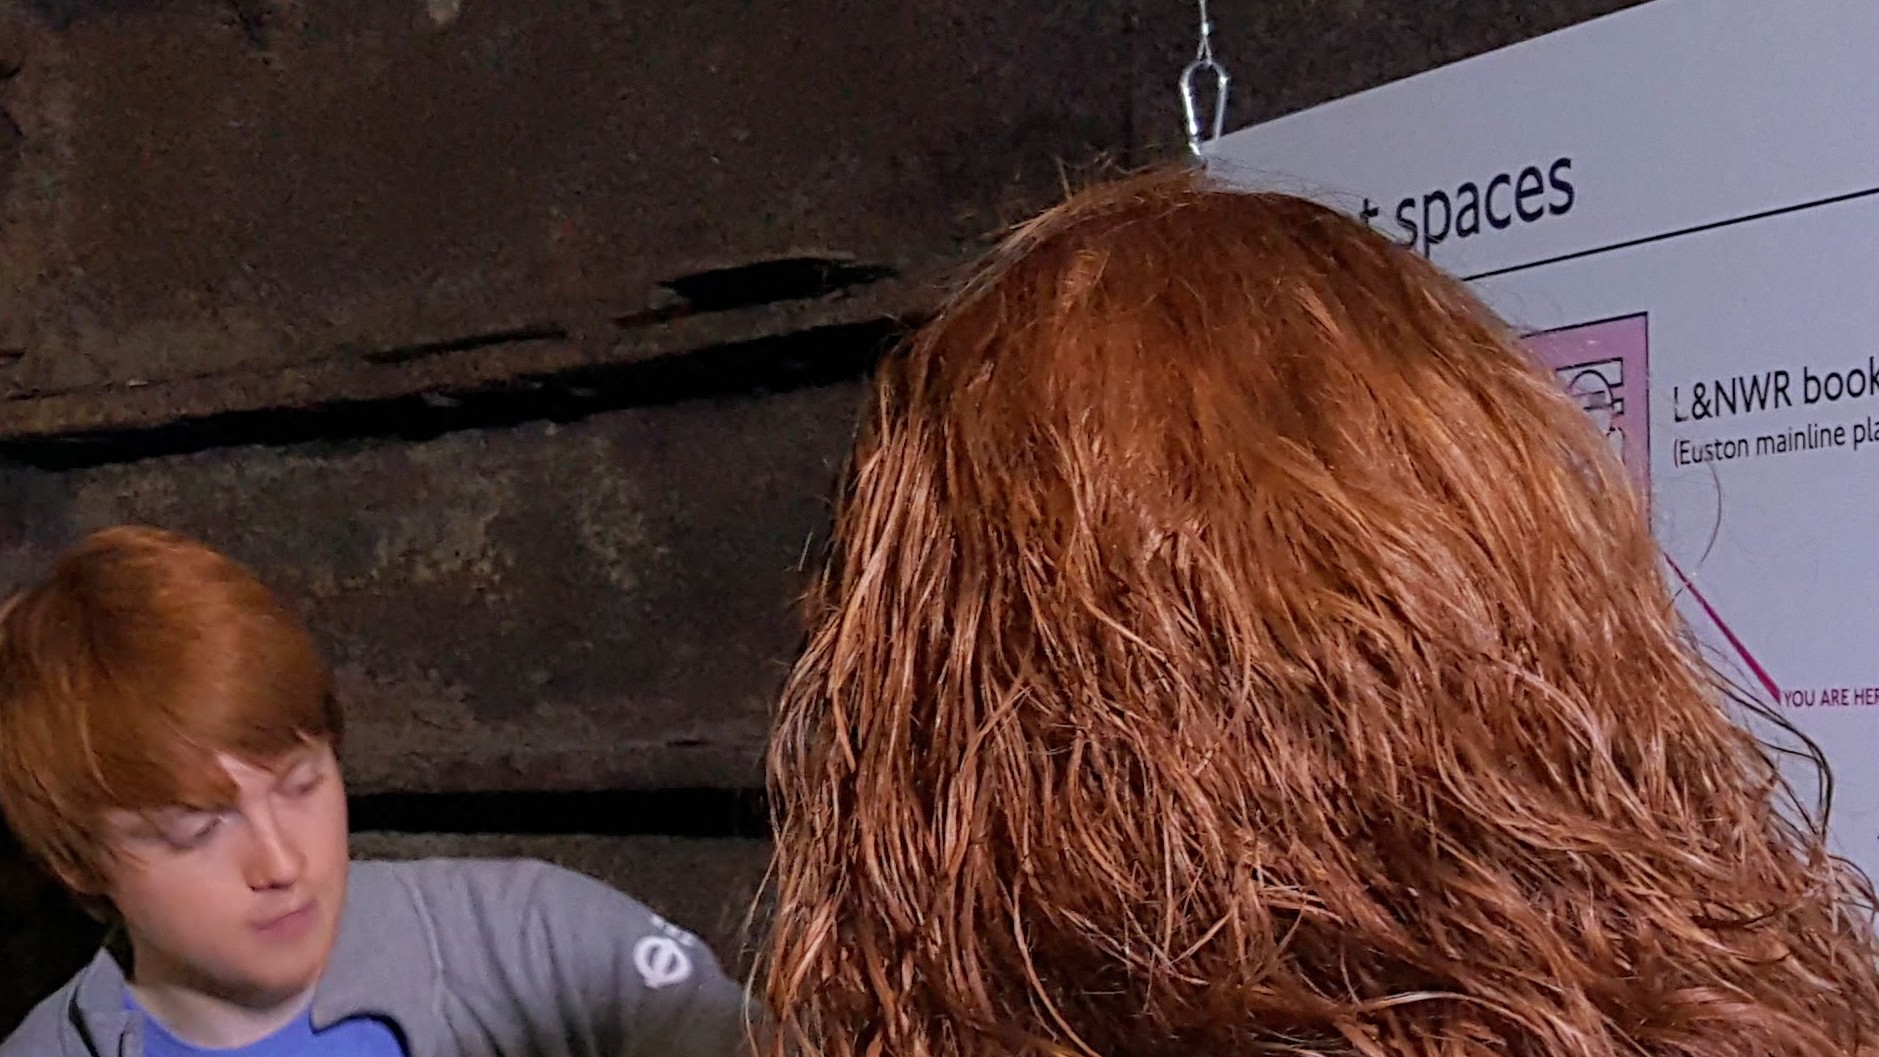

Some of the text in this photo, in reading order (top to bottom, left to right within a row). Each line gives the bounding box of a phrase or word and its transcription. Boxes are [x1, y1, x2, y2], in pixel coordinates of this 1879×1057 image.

[1395, 157, 1575, 259] spaces
[1674, 370, 1792, 423] L&NWR
[1674, 437, 1749, 468] (Euston
[1756, 423, 1845, 456] mainline
[1784, 690, 1816, 707] YOU
[1820, 688, 1850, 706] ARE
